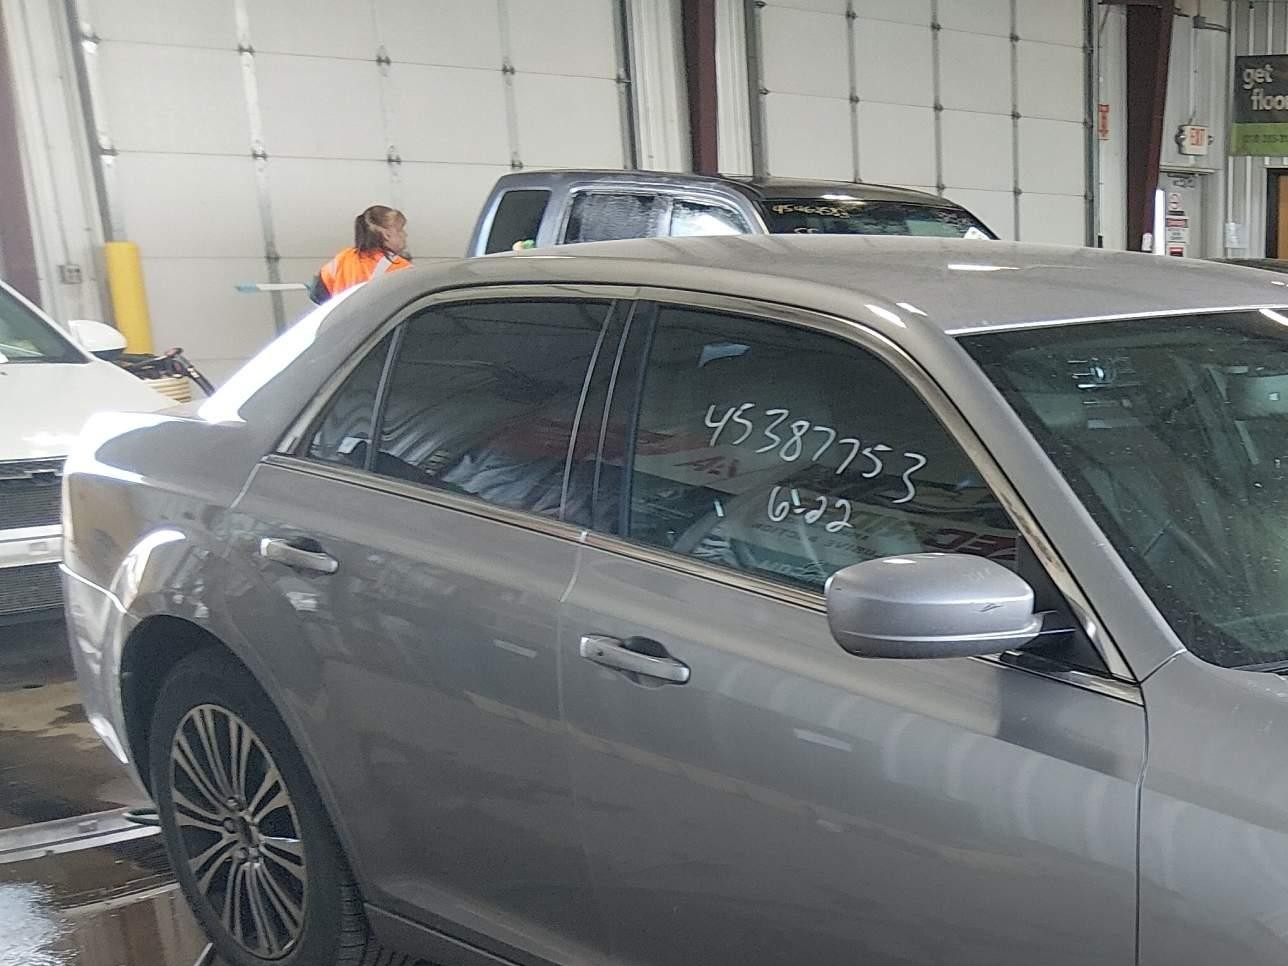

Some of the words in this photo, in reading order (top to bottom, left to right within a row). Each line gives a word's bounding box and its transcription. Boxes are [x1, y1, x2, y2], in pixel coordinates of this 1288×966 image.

[1242, 64, 1274, 90] get
[704, 403, 927, 503] 45387753
[768, 486, 854, 532] 6-22
